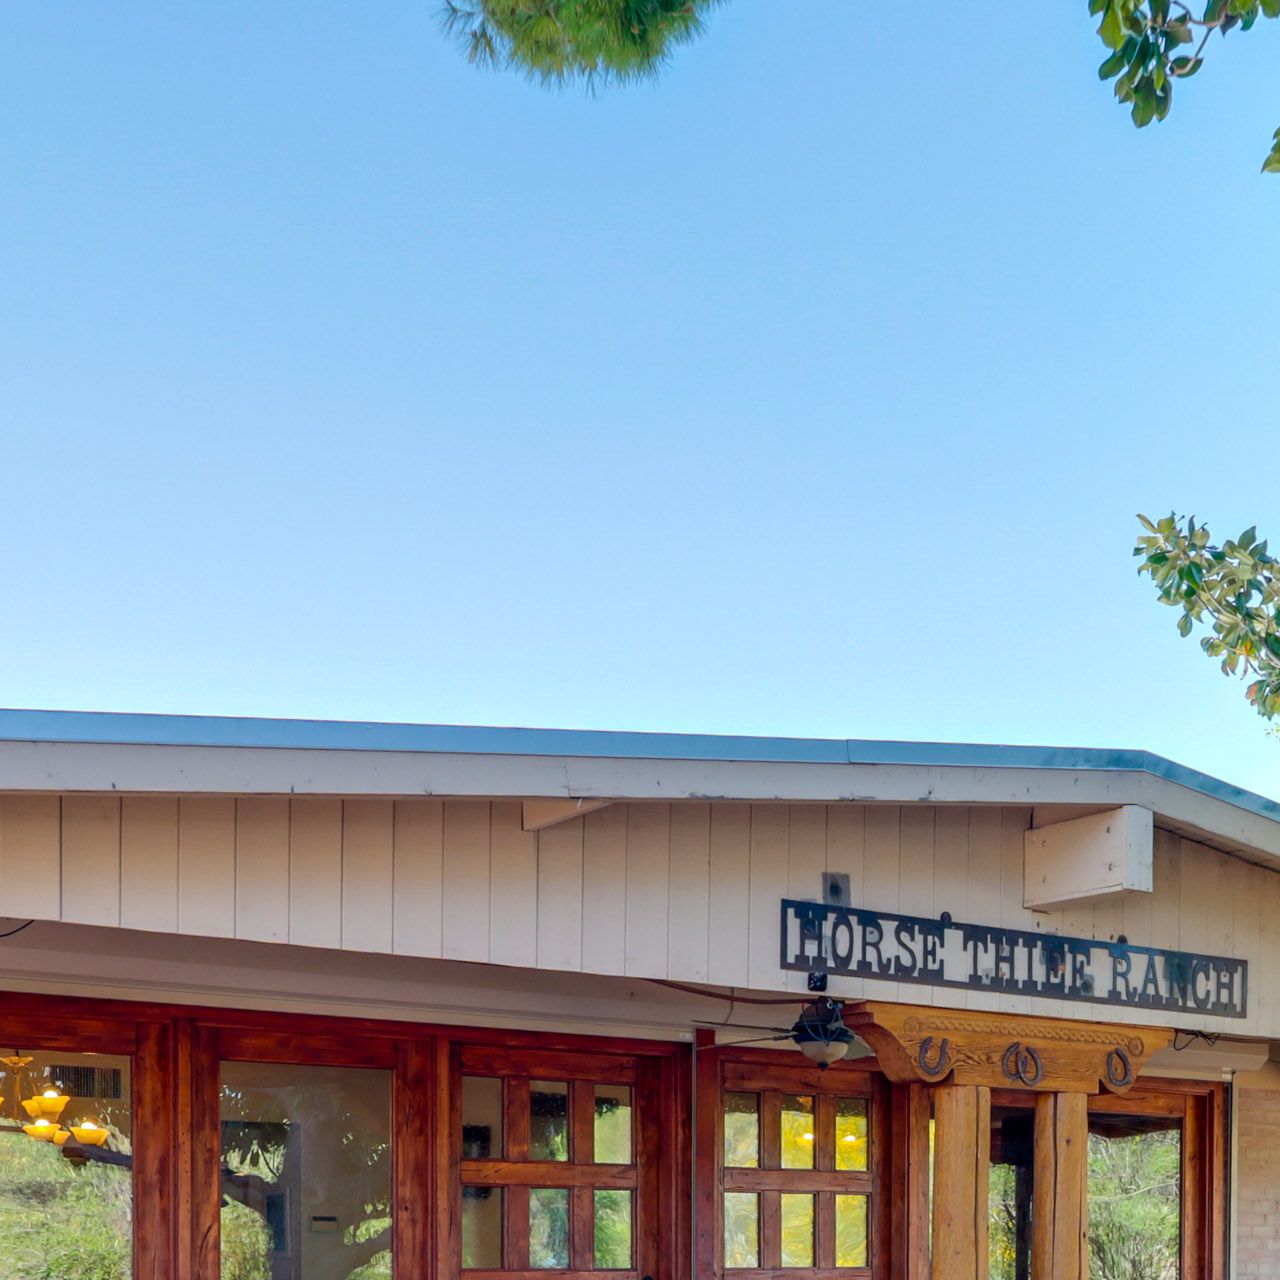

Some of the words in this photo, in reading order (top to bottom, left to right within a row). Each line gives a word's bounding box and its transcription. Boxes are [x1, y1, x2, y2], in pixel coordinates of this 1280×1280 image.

[794, 904, 944, 980] HORSE
[963, 928, 1091, 996] THIEF
[1108, 948, 1238, 1013] RANCH
